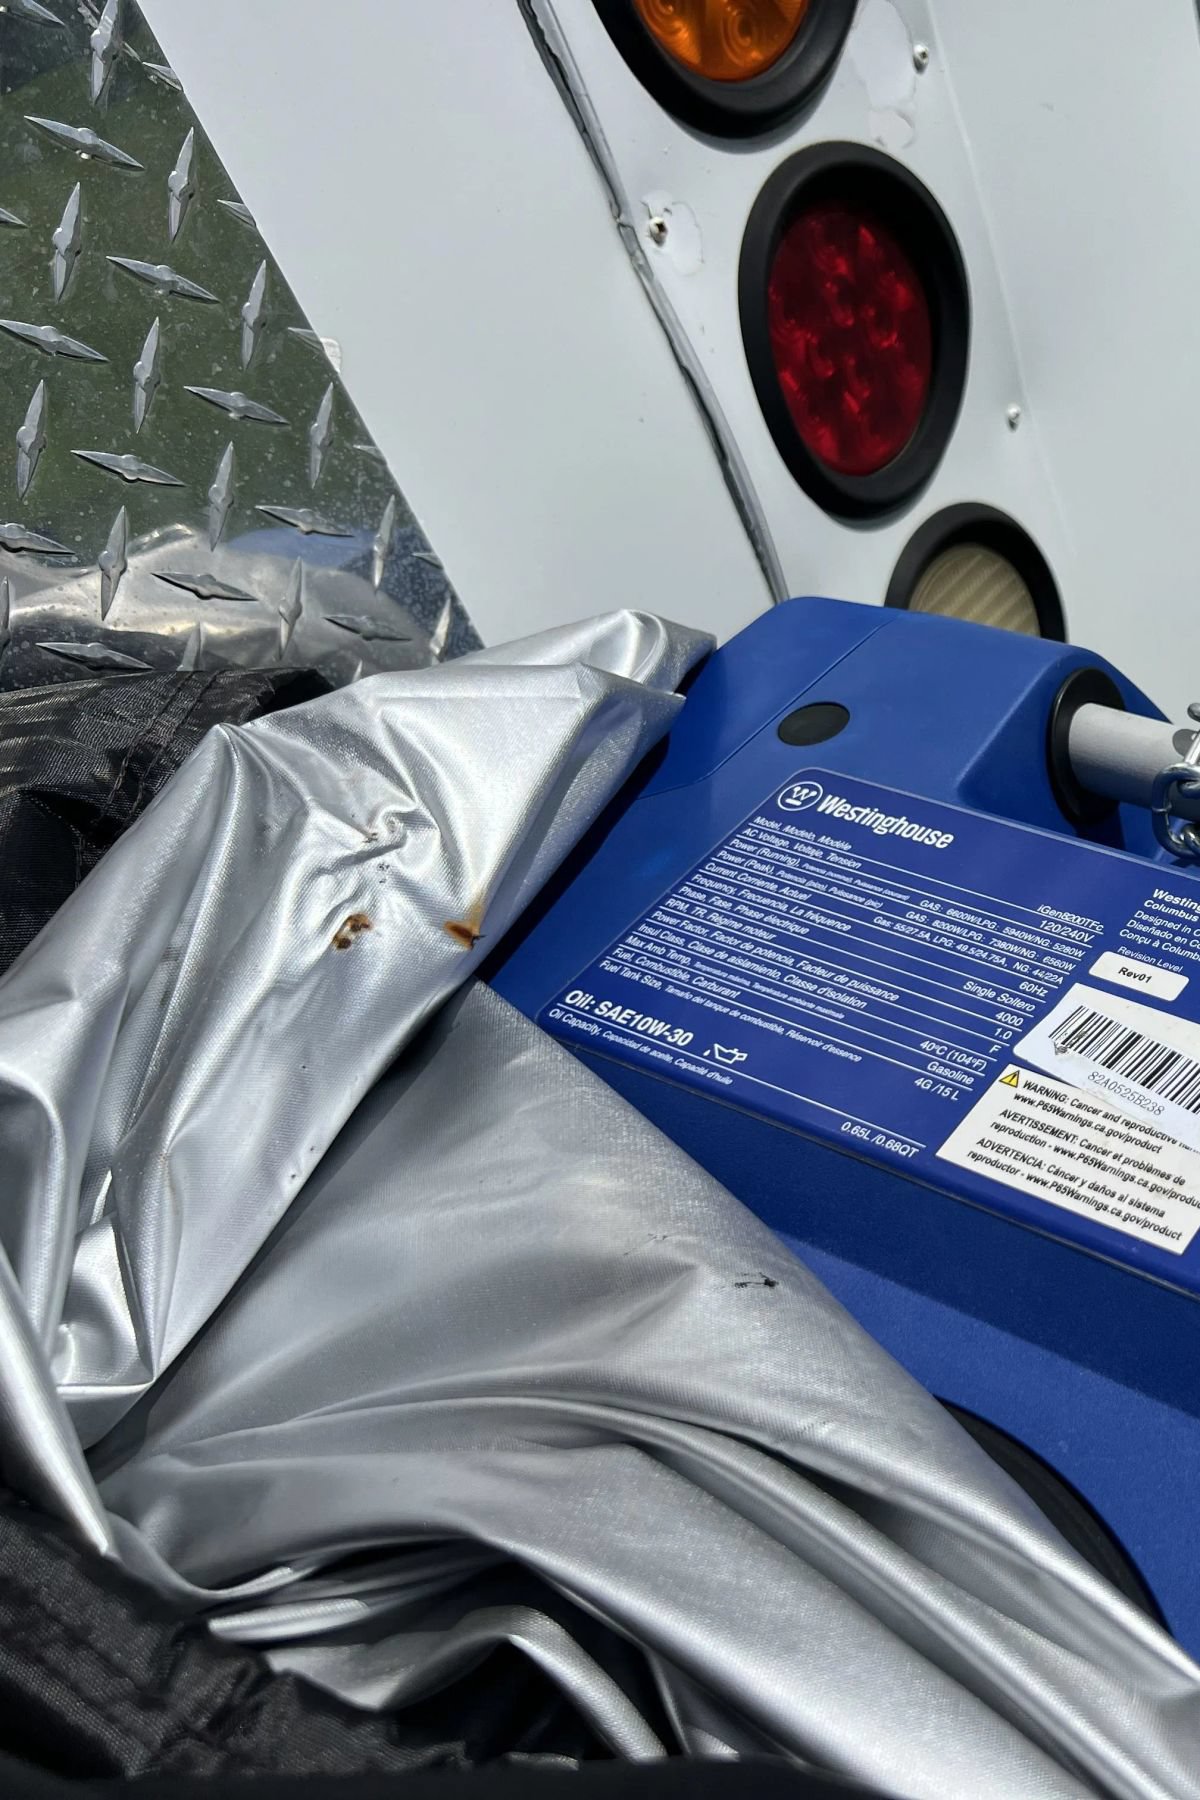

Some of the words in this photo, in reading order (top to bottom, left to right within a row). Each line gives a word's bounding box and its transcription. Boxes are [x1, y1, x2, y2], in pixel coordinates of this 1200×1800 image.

[815, 793, 955, 849] Westinghouse
[703, 861, 739, 879] Current
[741, 826, 760, 838] AC
[757, 830, 791, 851] Voltage,
[821, 851, 863, 872] Tension
[1038, 918, 1096, 943] 120/240V
[752, 815, 783, 831] Model,
[780, 823, 817, 842] Modelo,
[1035, 903, 1105, 932] iGen8200TFc
[690, 872, 738, 896] Frequency,
[736, 887, 790, 913] Frecuencia,
[788, 904, 806, 917] La
[802, 909, 853, 932] fréquence
[1018, 980, 1049, 998] 60Hz
[1133, 909, 1183, 931] Designed
[1180, 923, 1193, 935] in
[1142, 898, 1200, 923] Columbus
[677, 884, 708, 903] Phase,
[707, 894, 734, 911] Fase,
[732, 903, 766, 920] Phase
[762, 913, 811, 936] électrique
[962, 979, 997, 999] Single
[995, 991, 1036, 1012] Soltero
[1116, 945, 1157, 965] Revision
[1155, 957, 1184, 973] Level
[1117, 965, 1153, 984] Rev01
[564, 989, 596, 1011] Oil:
[592, 999, 695, 1047] SAE10W-30
[598, 958, 623, 974] Fuel
[618, 965, 643, 982] Tank
[639, 973, 663, 991] Size,
[913, 1076, 934, 1090] 4G
[611, 946, 636, 963] Fuel,
[633, 955, 691, 983] Combustible,
[690, 975, 742, 1000] Carburant
[926, 1060, 975, 1086] Gasoline
[993, 1026, 1014, 1041] 1.0
[994, 1010, 1025, 1027] 4000
[547, 1007, 566, 1020] Oil
[560, 1012, 603, 1036] Capacity,
[839, 1120, 872, 1141] 0.65L
[1021, 1079, 1070, 1104] WARNING:
[1069, 1097, 1104, 1116] Cancer
[1100, 1110, 1123, 1124] and
[1086, 1070, 1166, 1117] 82A0525B238
[989, 1120, 1048, 1148] reproduction
[998, 1108, 1079, 1145] AVERTISSEMENT:
[1078, 1137, 1113, 1158] Cancer
[1111, 1152, 1124, 1162] et
[1120, 1156, 1173, 1181] problèmes
[1171, 1174, 1187, 1187] de
[1012, 1092, 1163, 1155] www.P65Warnings.ca.gov/product
[966, 1149, 1021, 1176] reproductor
[1025, 1172, 1183, 1241] www.P65Warnings.ca.gov/product
[974, 1136, 1047, 1170] ADVERTENCIA:
[1045, 1163, 1081, 1184] Cáncer
[1076, 1177, 1088, 1189] y
[1086, 1180, 1117, 1199] daños
[1116, 1193, 1130, 1203] al
[1126, 1197, 1166, 1219] sistema
